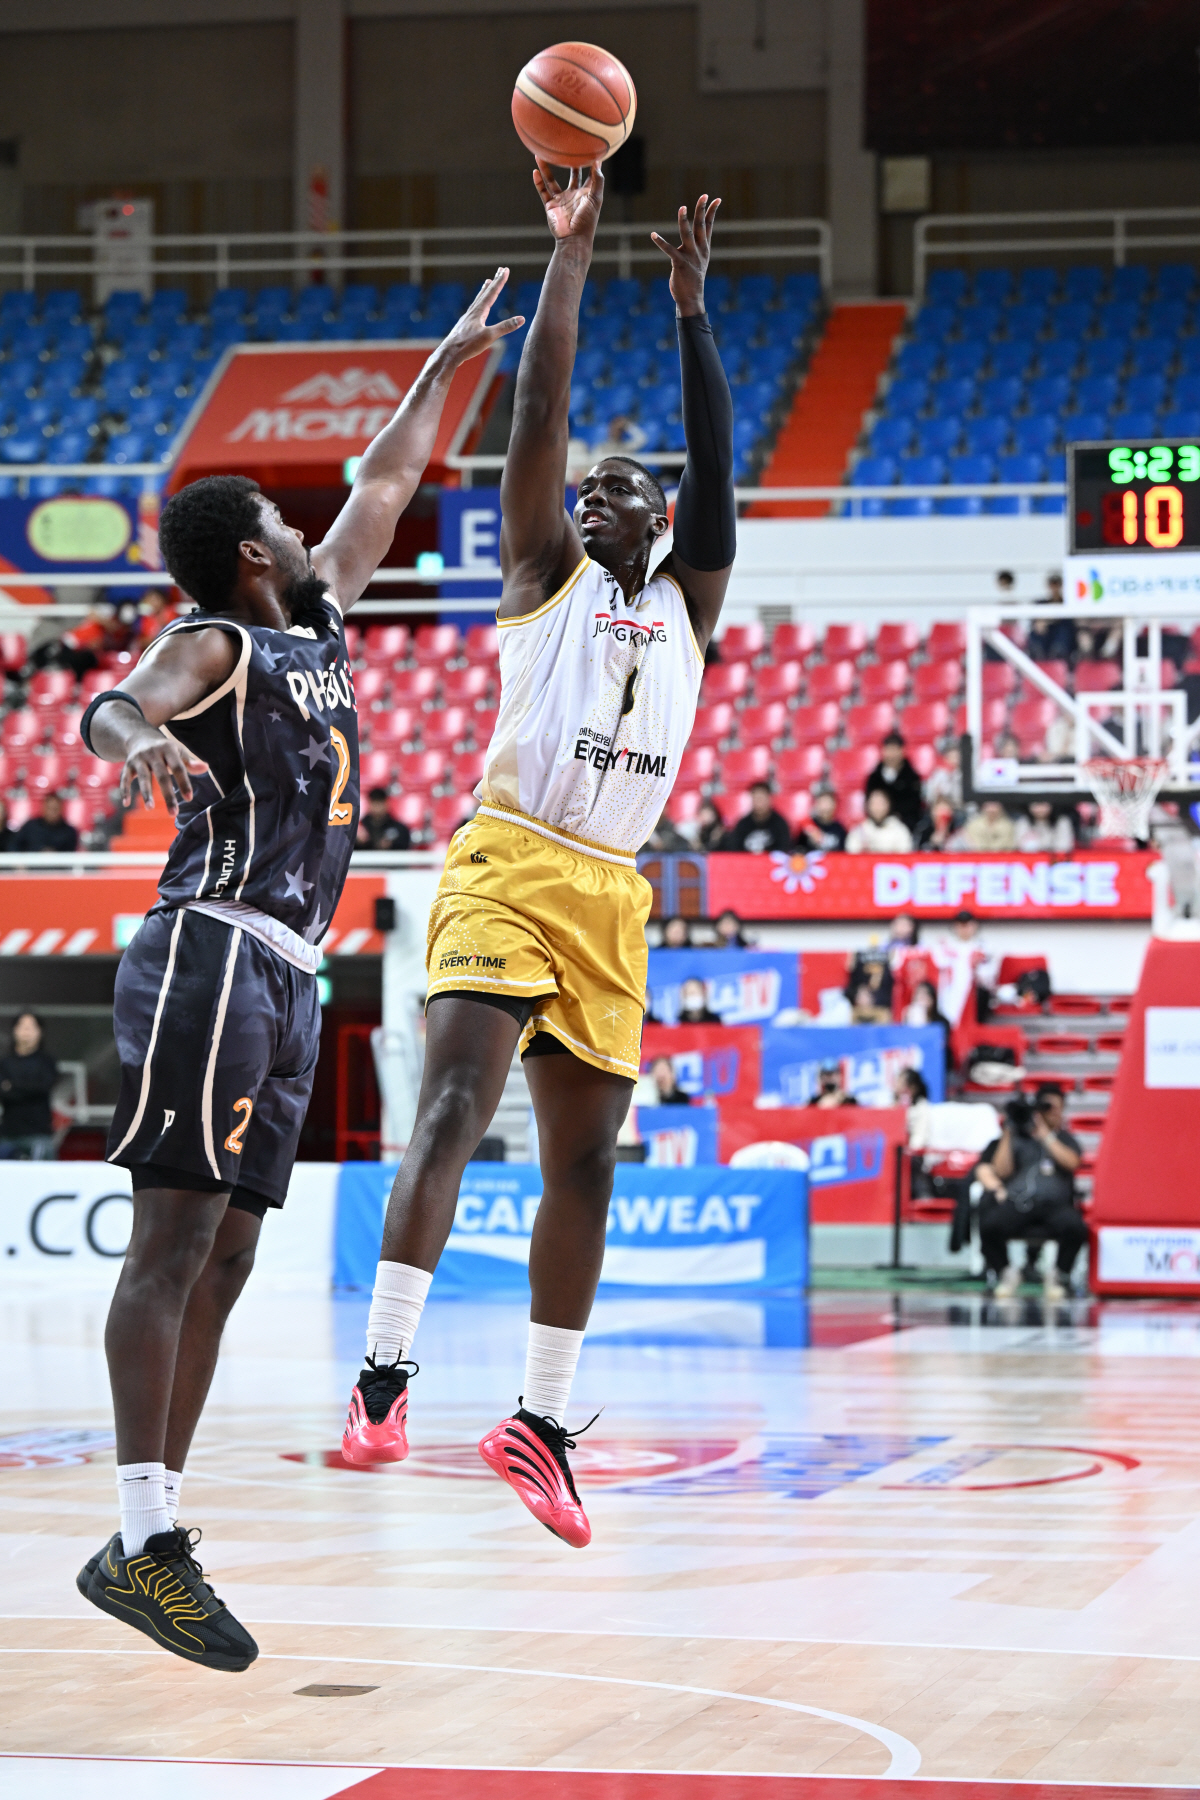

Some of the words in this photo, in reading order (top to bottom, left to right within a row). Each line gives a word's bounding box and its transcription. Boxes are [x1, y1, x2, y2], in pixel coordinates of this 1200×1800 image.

[1109, 445, 1200, 484] 5:23
[1123, 485, 1183, 549] 10
[327, 726, 353, 826] 2
[873, 861, 1120, 907] DEFENSE
[161, 1108, 176, 1136] P
[224, 1097, 253, 1155] 2
